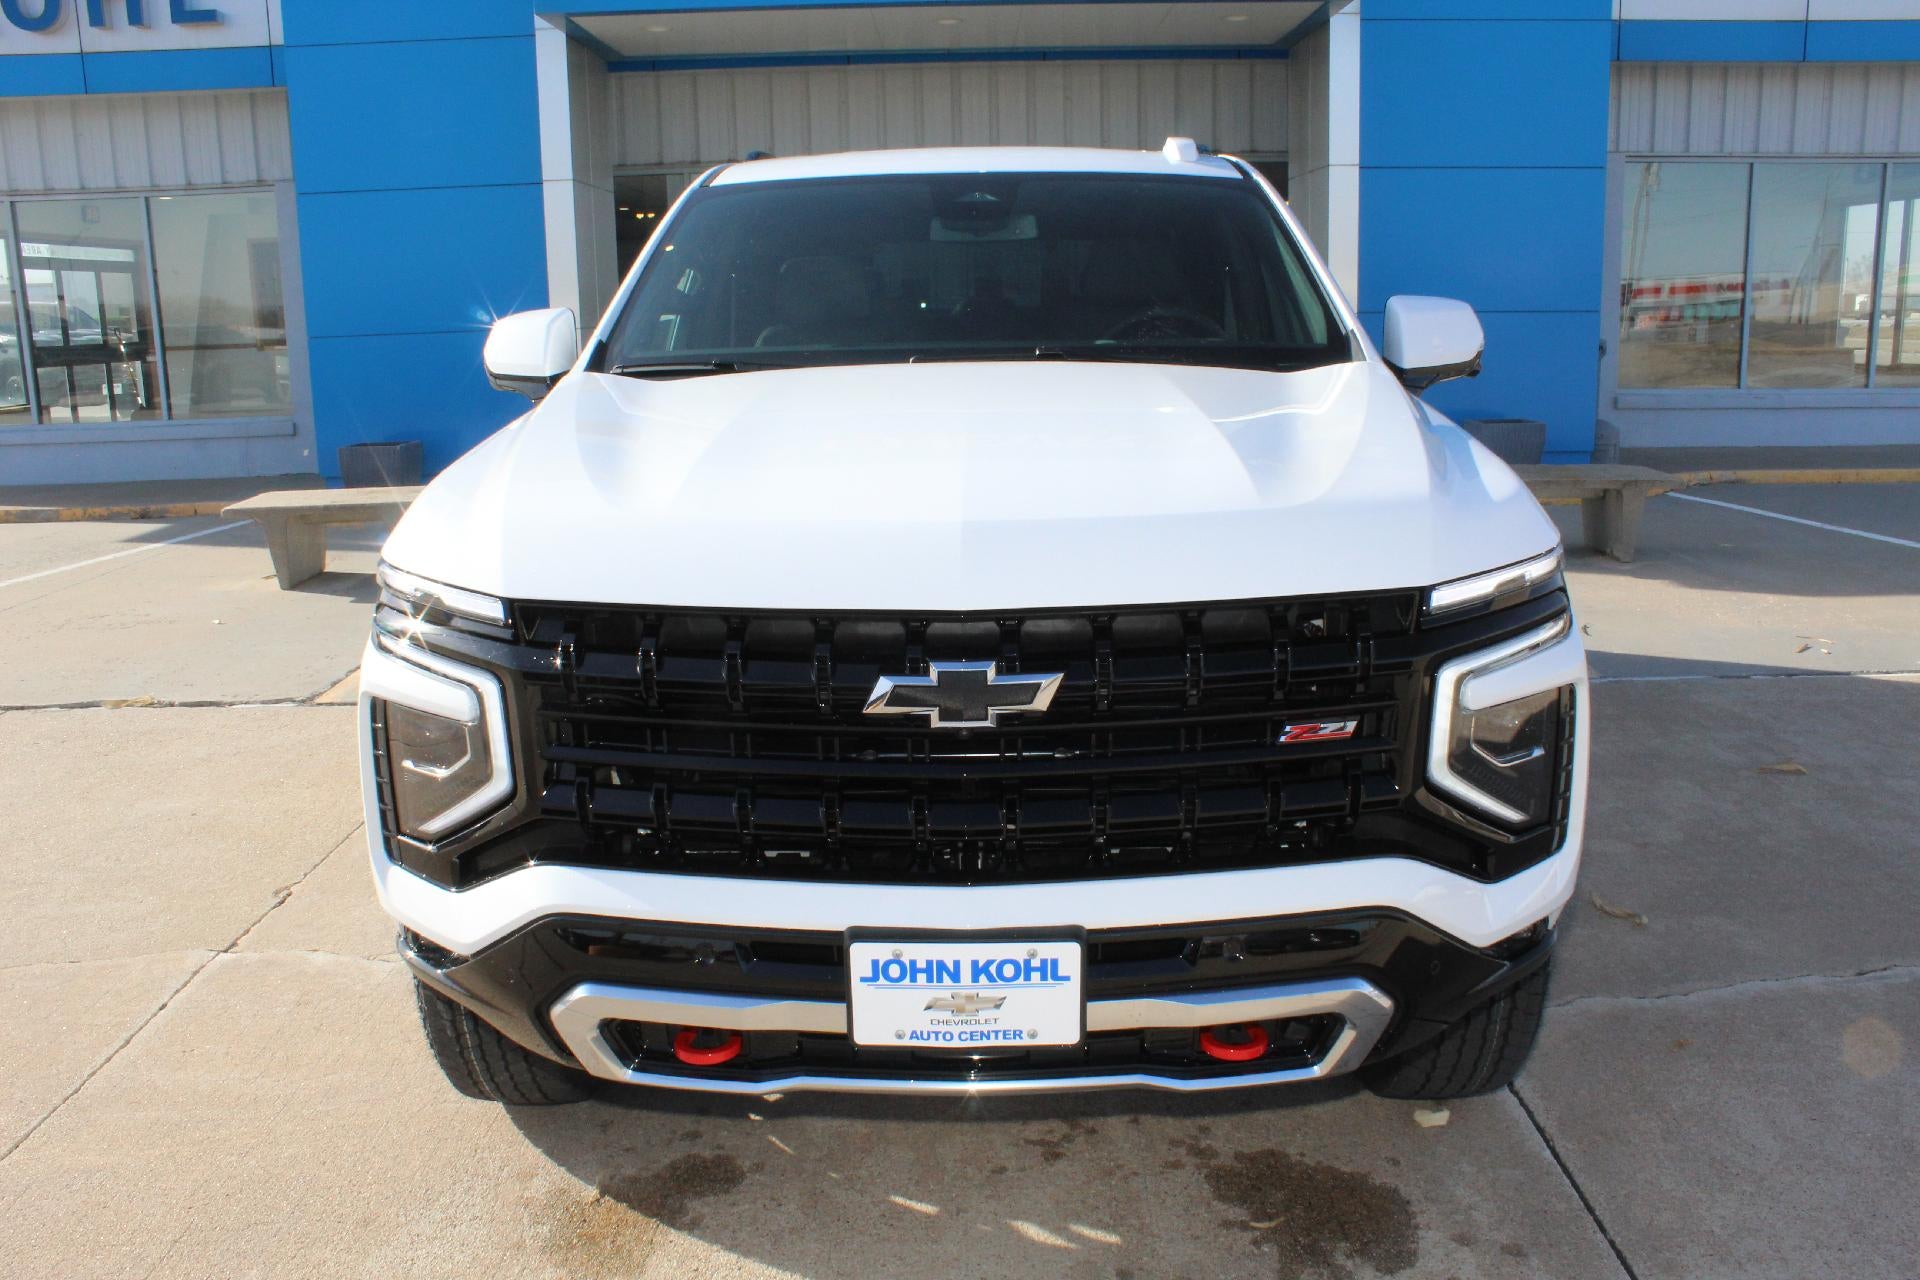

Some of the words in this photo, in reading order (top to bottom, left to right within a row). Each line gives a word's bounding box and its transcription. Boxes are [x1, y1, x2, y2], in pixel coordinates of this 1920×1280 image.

[1280, 720, 1358, 742] Z71
[860, 958, 961, 984] JOHN
[971, 958, 1071, 984] KOHL
[930, 1017, 999, 1026] CHEVROLET
[909, 1030, 954, 1042] AUTO
[958, 1029, 1024, 1042] CENTER
